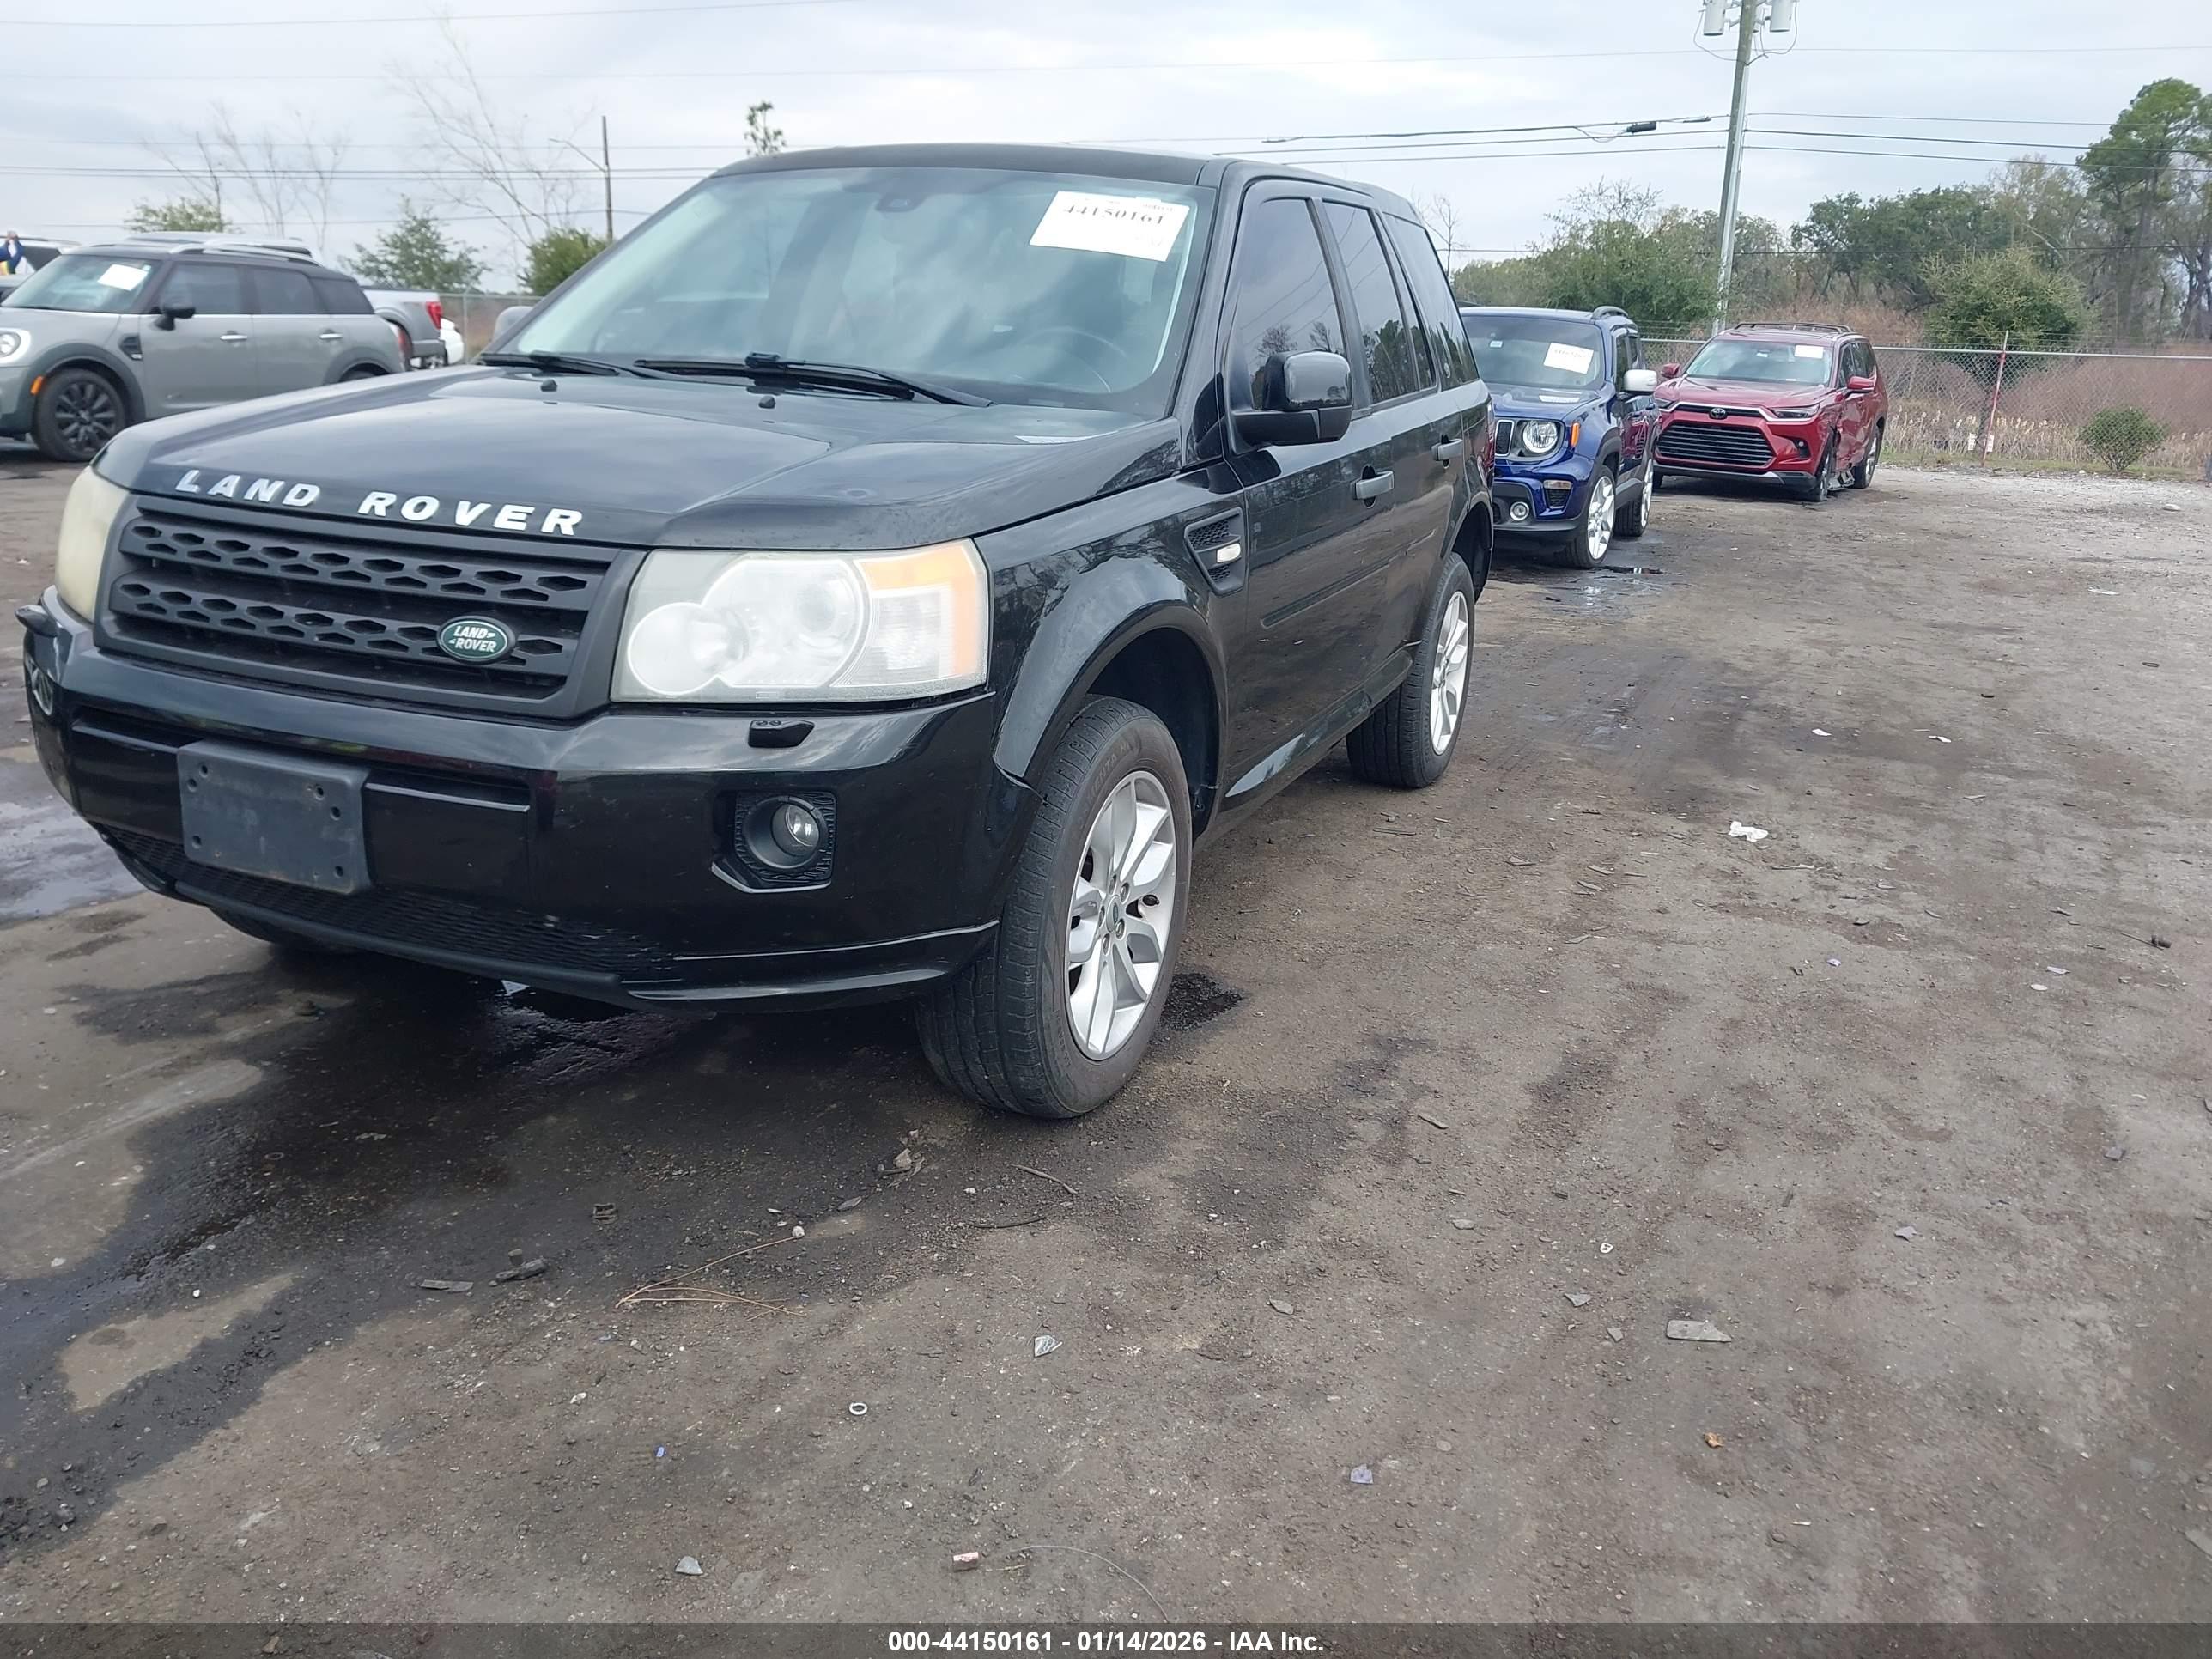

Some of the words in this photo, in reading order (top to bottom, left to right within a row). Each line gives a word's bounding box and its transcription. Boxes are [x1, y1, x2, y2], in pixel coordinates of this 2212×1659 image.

[1063, 204, 1164, 225] 44150161
[175, 469, 321, 507] LAND
[357, 491, 583, 536] ROVER
[453, 626, 488, 639] LAND
[455, 639, 497, 653] ROVER
